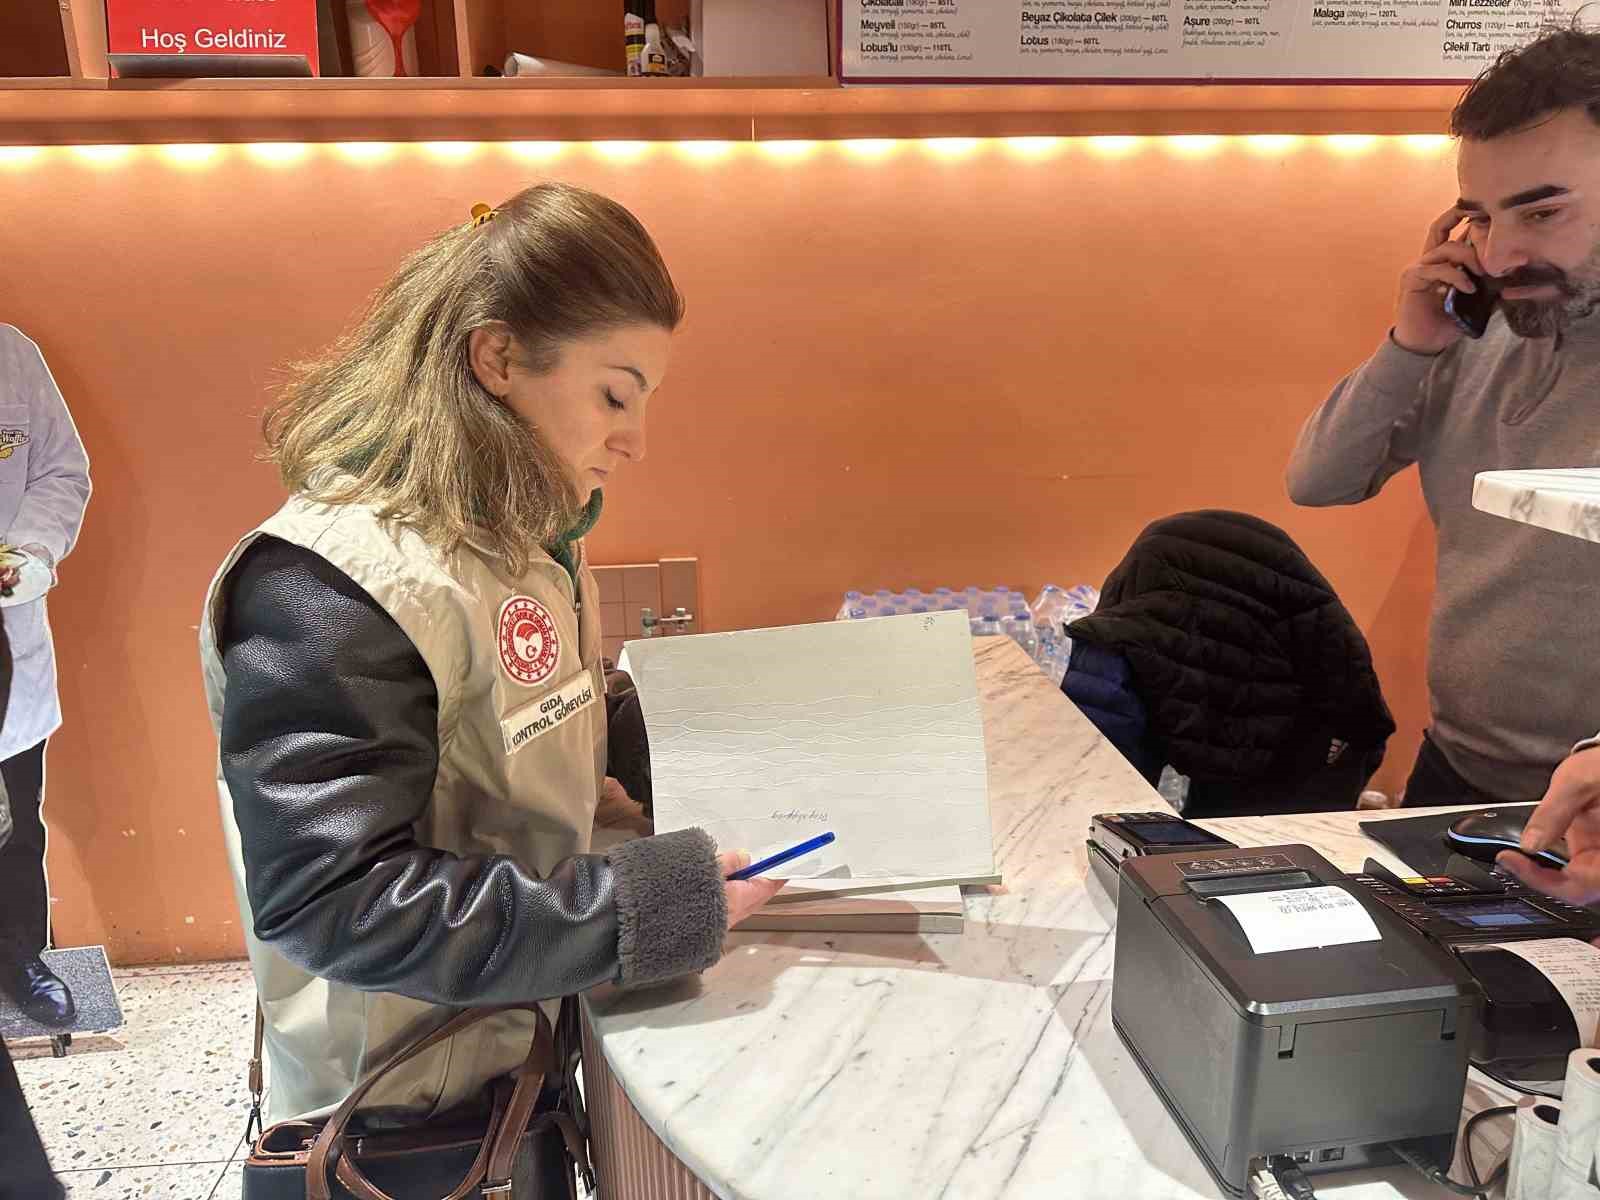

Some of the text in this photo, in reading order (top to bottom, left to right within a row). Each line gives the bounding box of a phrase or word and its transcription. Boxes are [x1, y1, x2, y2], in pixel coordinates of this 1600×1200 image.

[1021, 12, 1051, 24] Beyaz
[1053, 12, 1092, 24] Çikolata
[1094, 12, 1118, 24] Çilek
[1313, 8, 1345, 21] Malaga
[860, 19, 896, 32] Meyveli
[1183, 16, 1210, 28] Aşure
[1446, 19, 1482, 29] Churros
[141, 28, 287, 53] Hoş Geldiniz
[860, 42, 898, 52] Lotus'lu
[1020, 35, 1049, 46] Lotus
[1443, 41, 1470, 54] Çilekli
[539, 695, 565, 714] GIDA
[511, 716, 554, 746] KONTROL
